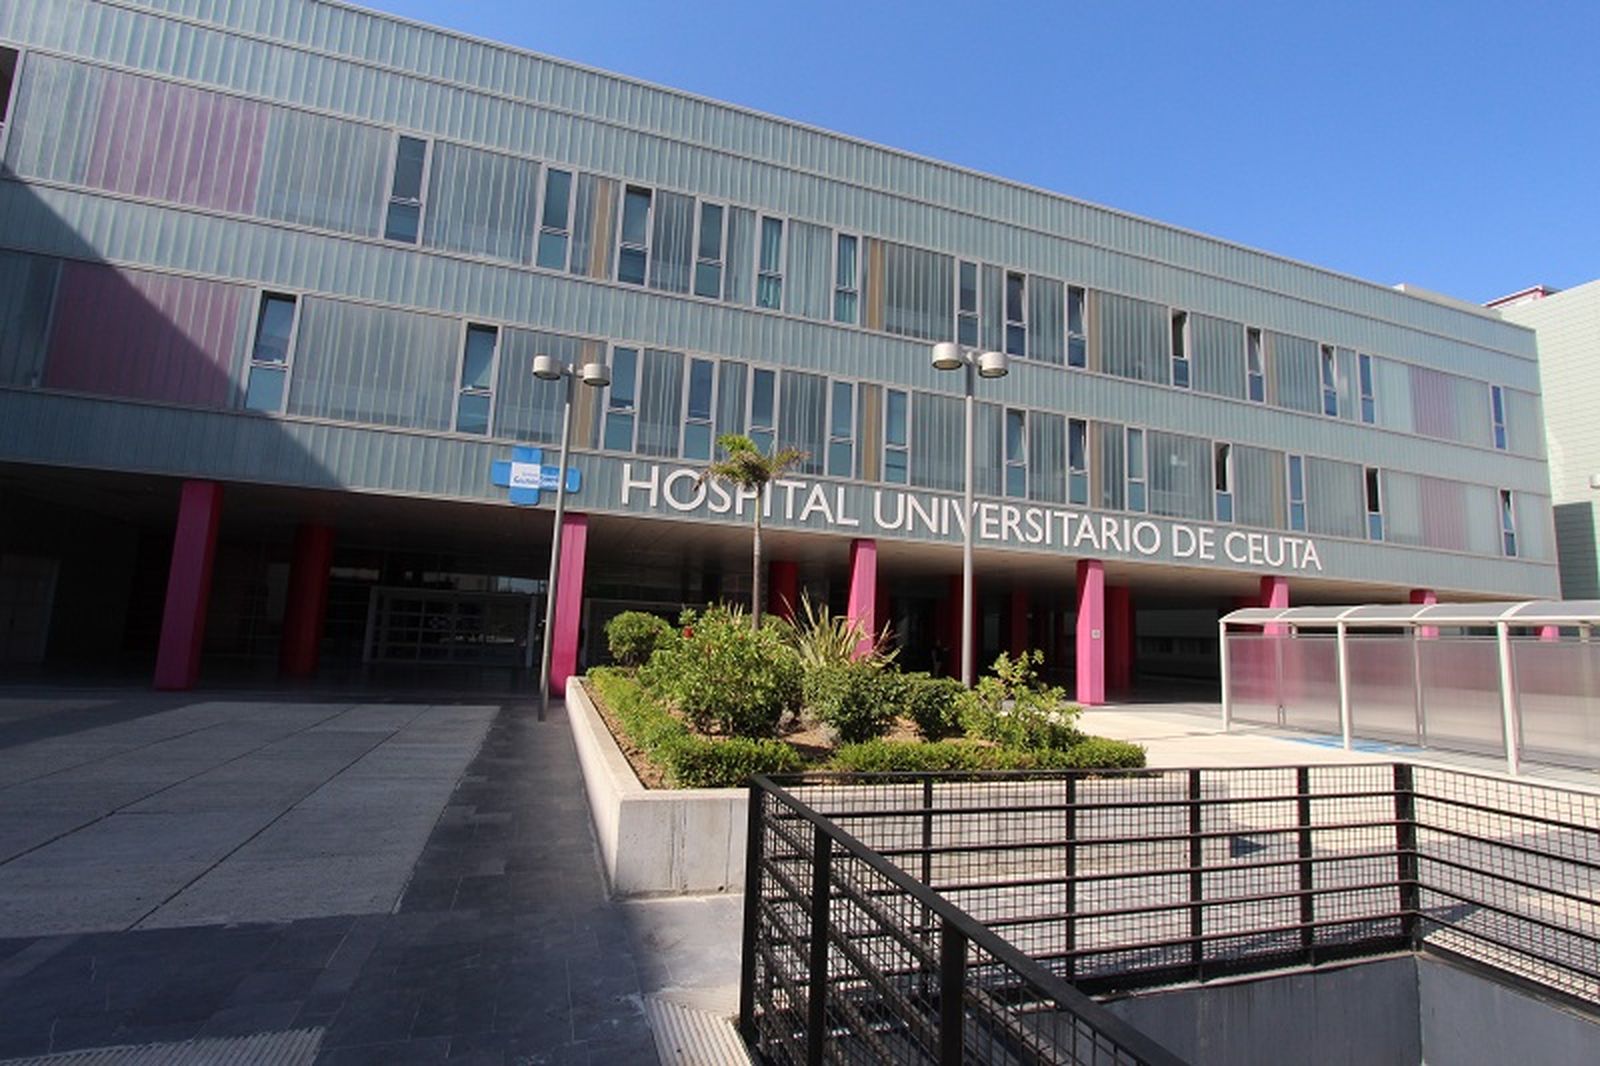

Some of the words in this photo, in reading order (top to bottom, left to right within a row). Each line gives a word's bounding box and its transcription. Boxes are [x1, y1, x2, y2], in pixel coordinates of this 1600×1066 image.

[873, 490, 1161, 555] UNIVERSITARIO
[1172, 524, 1215, 560] DE
[1224, 531, 1323, 571] CEUTA
